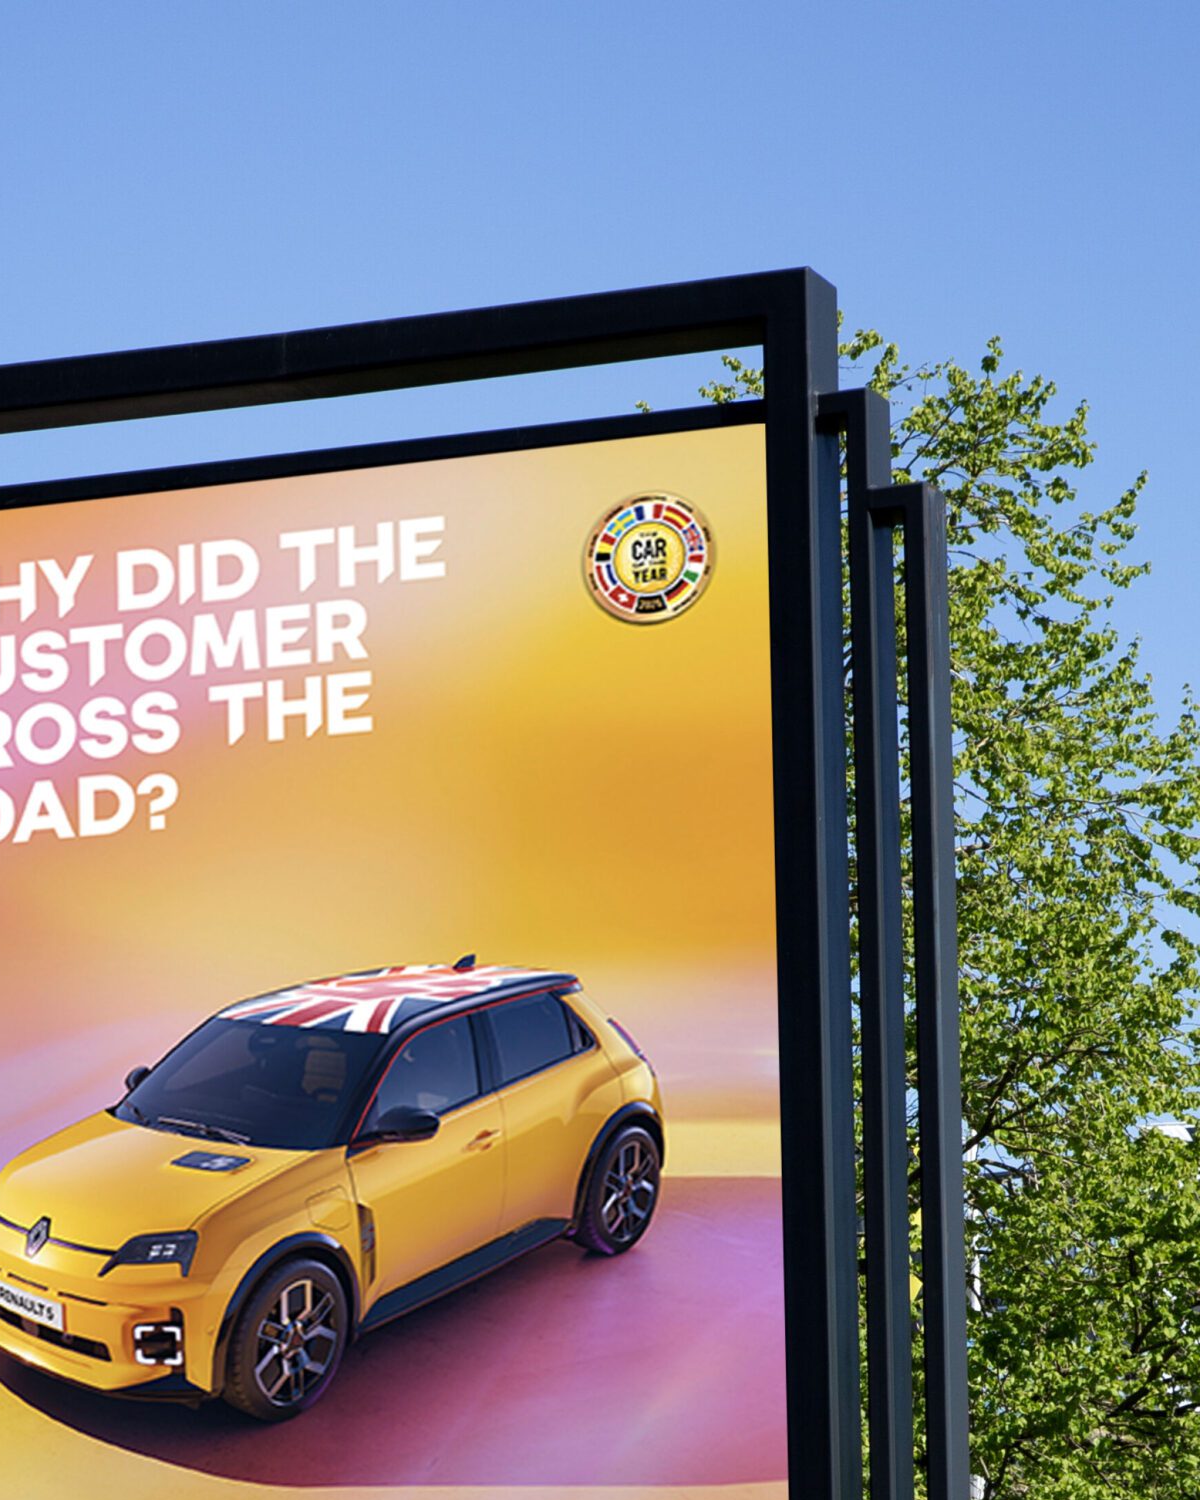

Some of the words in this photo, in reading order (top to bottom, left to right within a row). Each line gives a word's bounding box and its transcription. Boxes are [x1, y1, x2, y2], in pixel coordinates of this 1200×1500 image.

[117, 539, 259, 611] DID
[280, 516, 445, 592] THE
[631, 538, 667, 560] CAR
[632, 568, 667, 584] YEAR
[209, 672, 372, 744] THE
